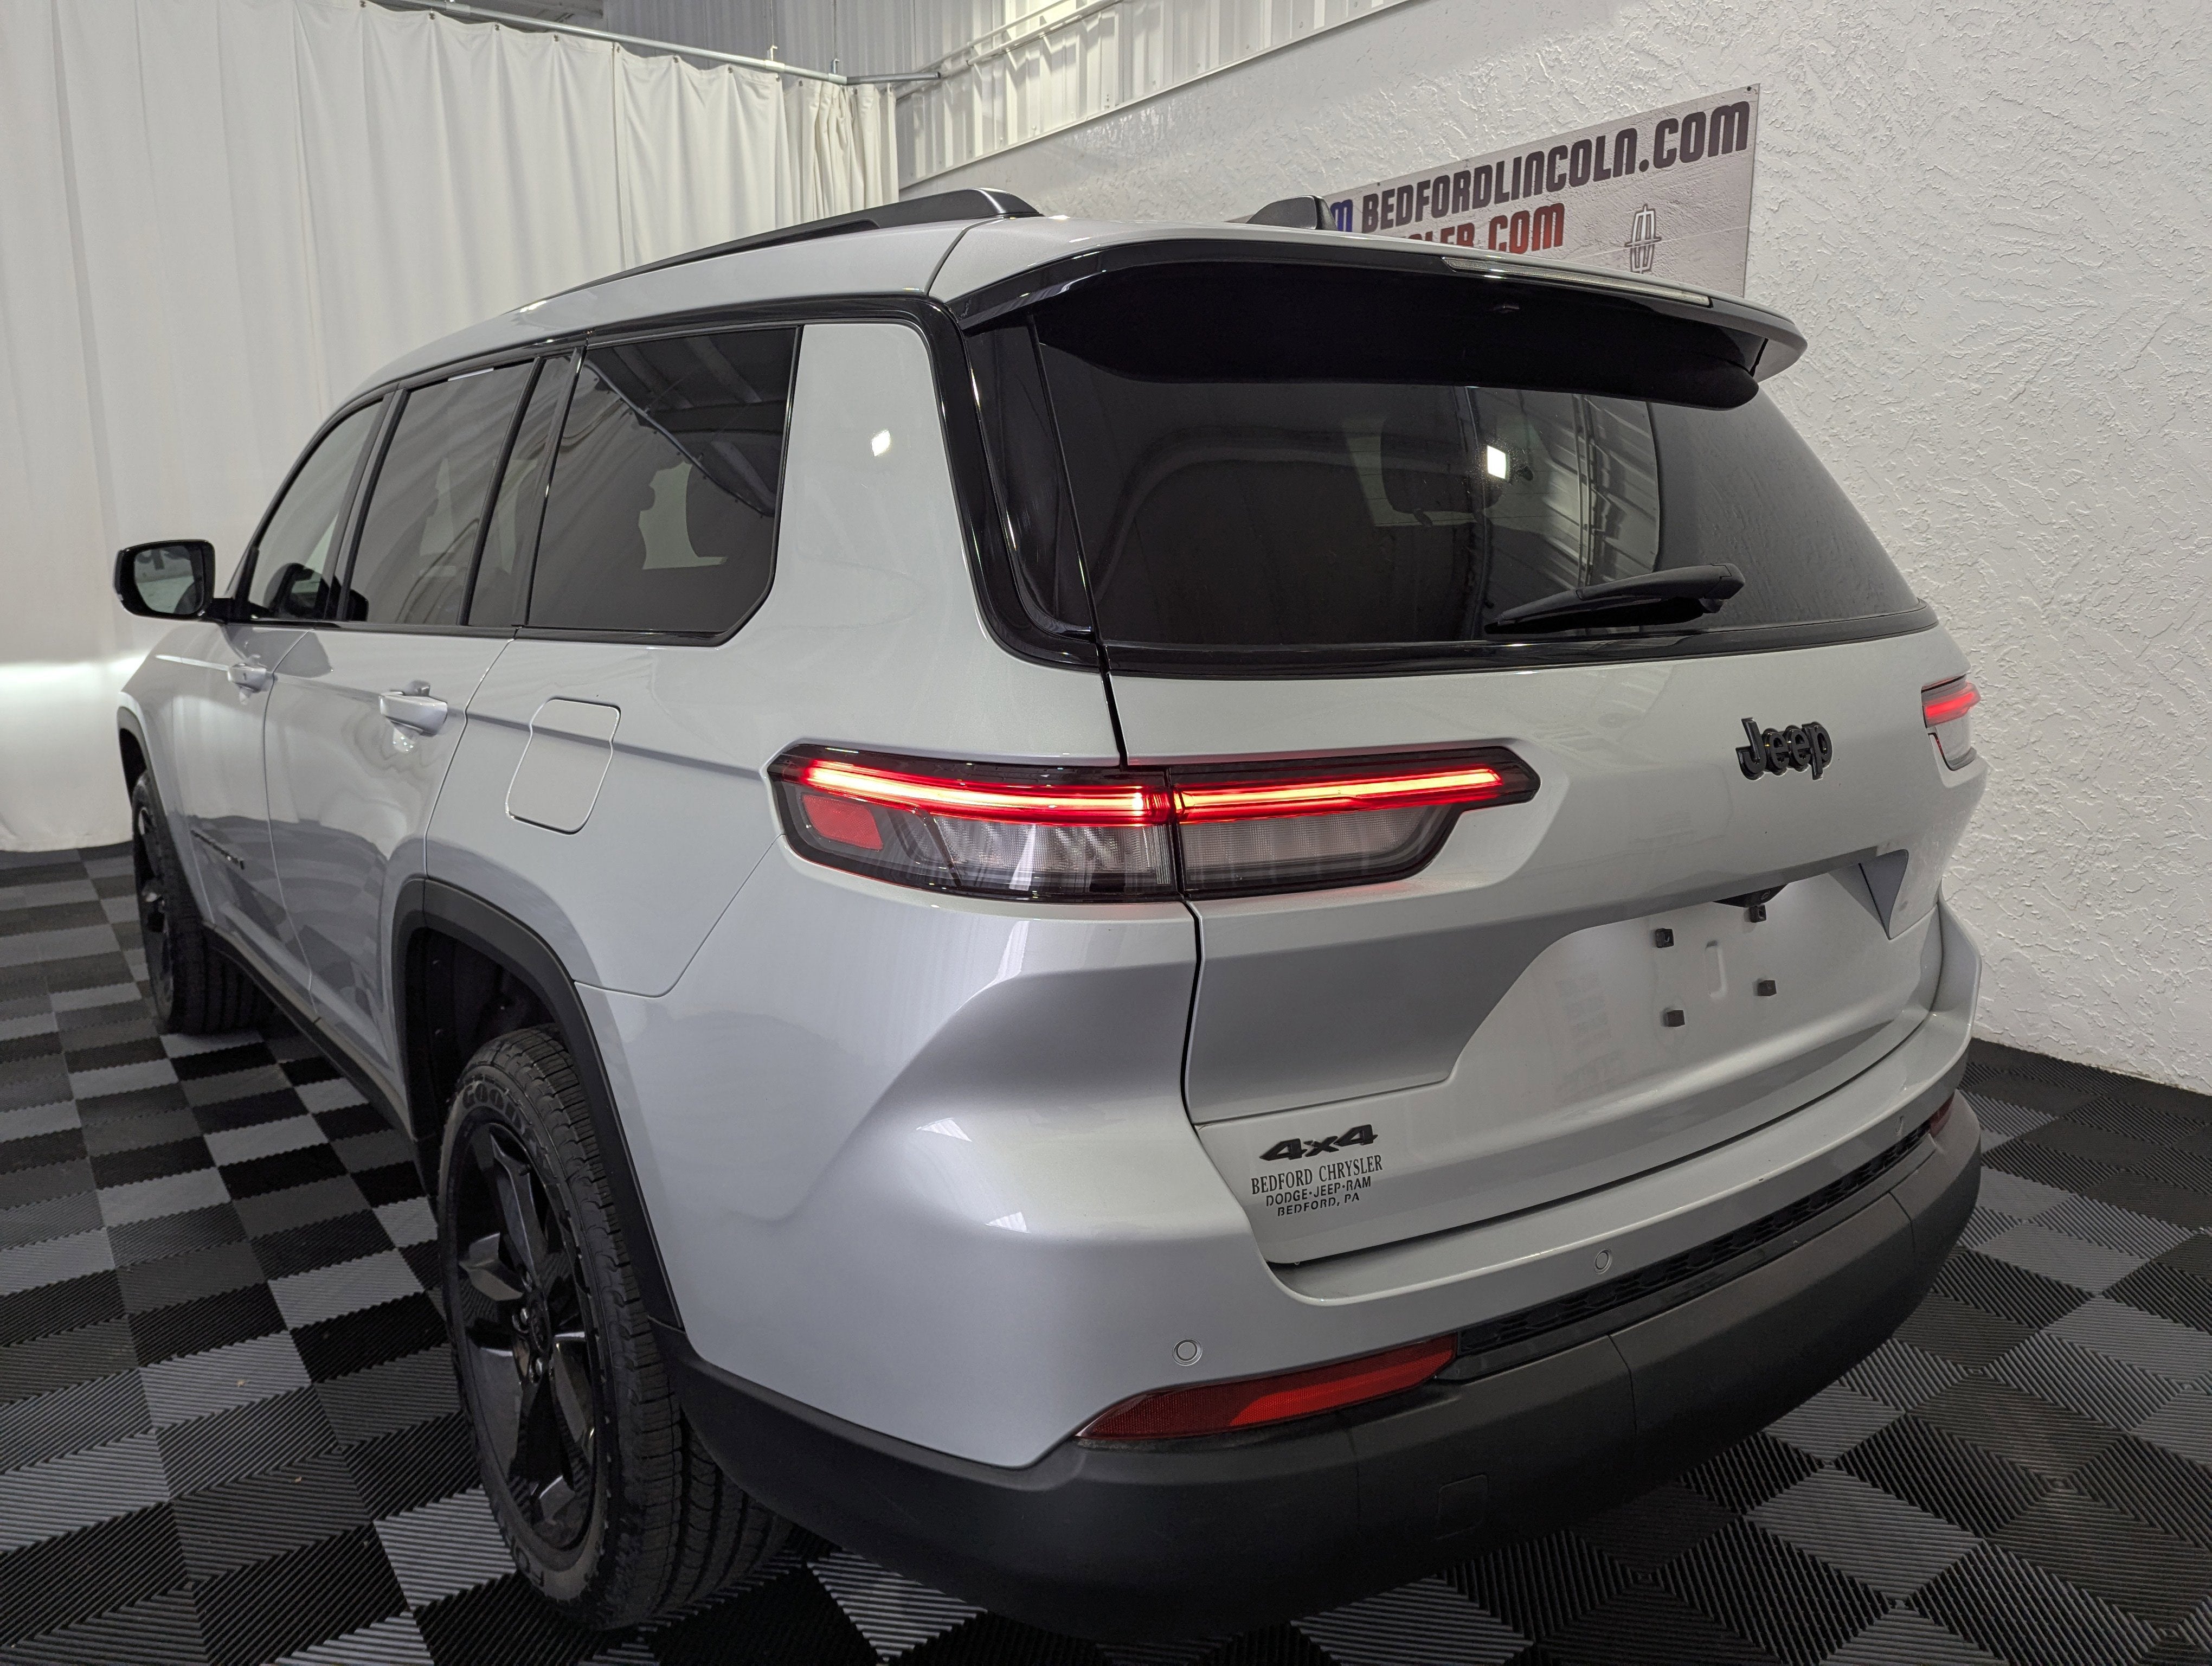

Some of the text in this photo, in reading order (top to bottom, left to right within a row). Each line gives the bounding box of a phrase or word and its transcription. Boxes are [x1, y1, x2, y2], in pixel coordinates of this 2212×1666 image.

[1361, 101, 1751, 233] BEDFORDLINCOLN.COM
[1735, 717, 1832, 780] Jeep
[1251, 1154, 1383, 1195] BEDFORD CHRYSLER
[1277, 1192, 1360, 1216] BEDFORD, PA
